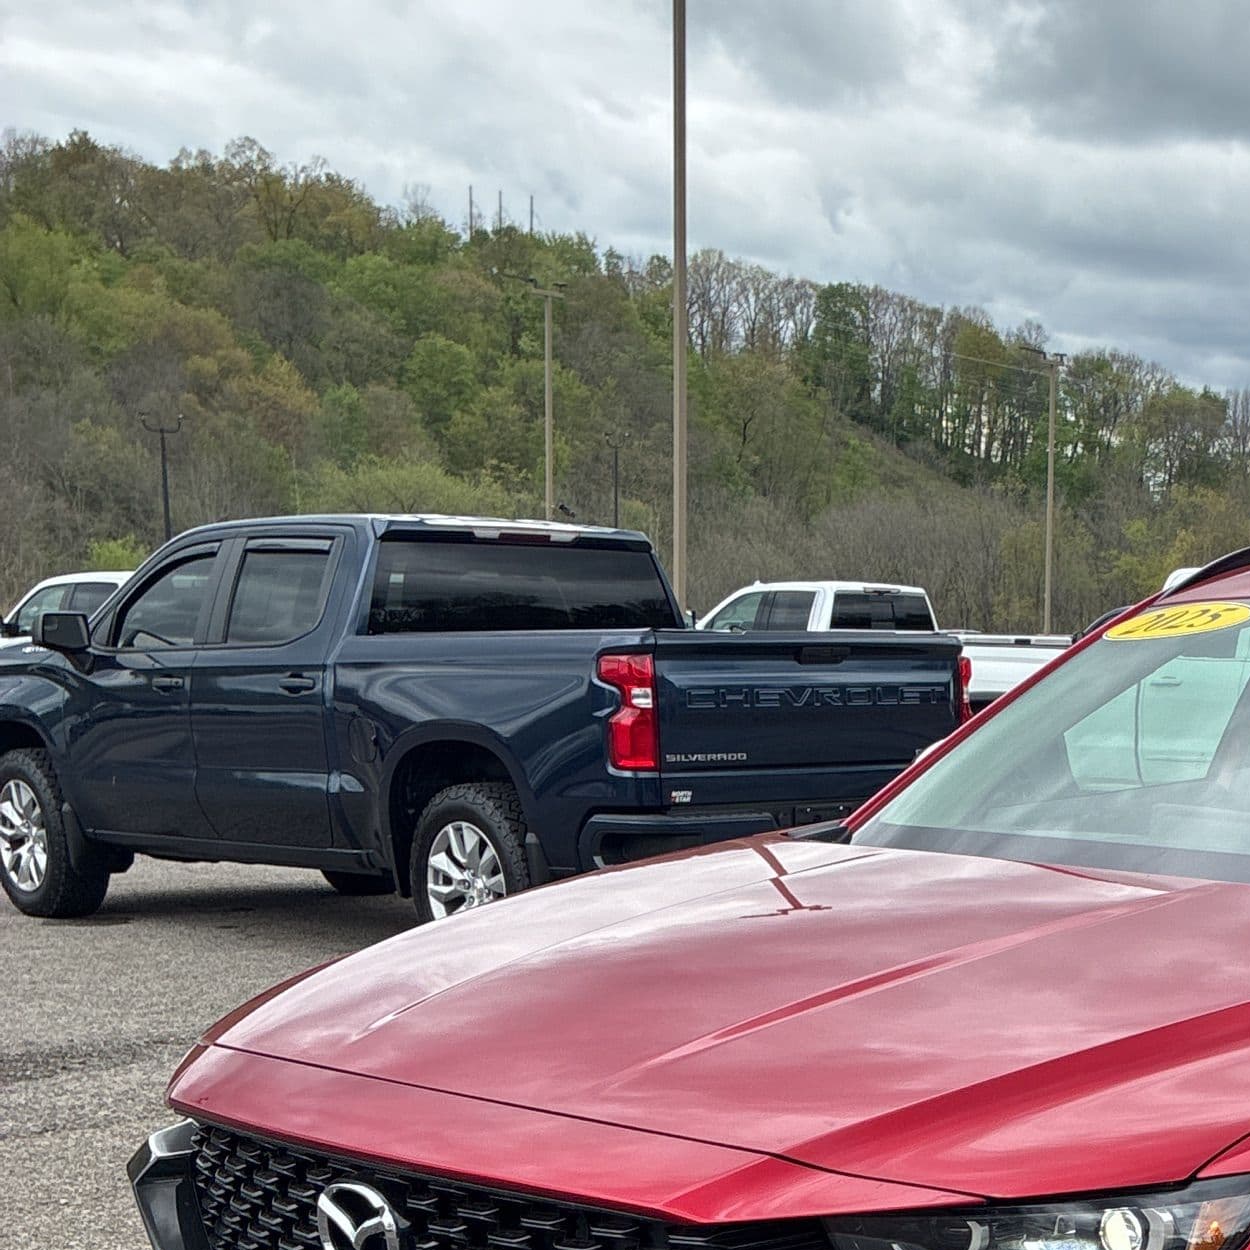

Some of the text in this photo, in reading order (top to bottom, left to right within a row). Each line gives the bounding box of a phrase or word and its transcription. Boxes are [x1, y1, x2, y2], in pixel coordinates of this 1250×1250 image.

[1116, 607, 1240, 637] 2025
[685, 686, 945, 709] CHEVROLET
[665, 752, 748, 762] SILVERADO
